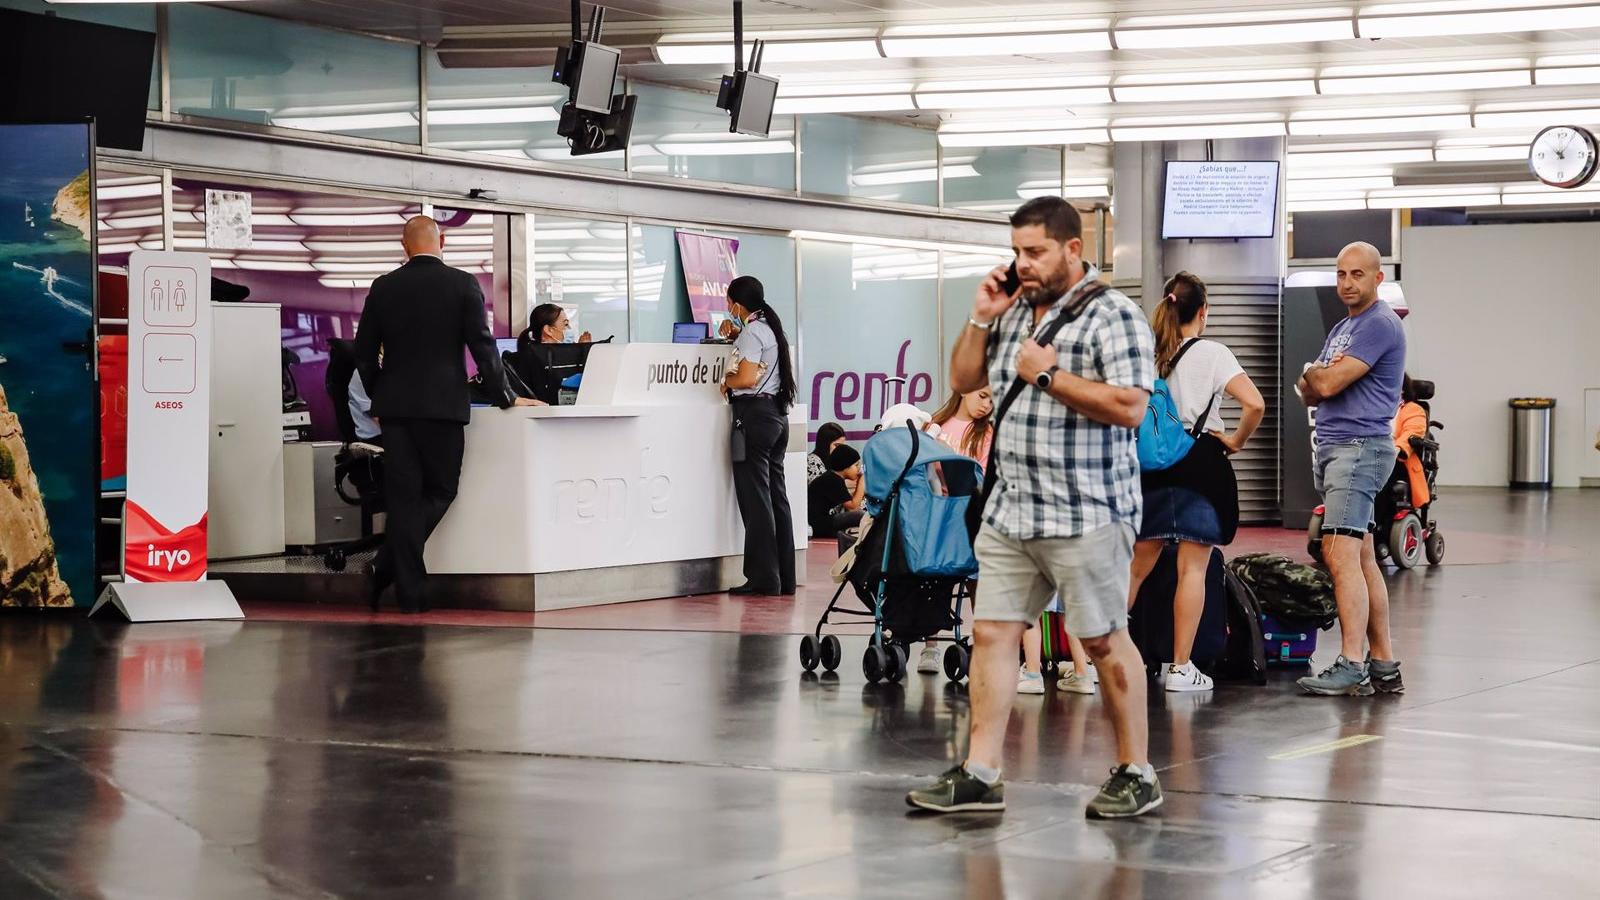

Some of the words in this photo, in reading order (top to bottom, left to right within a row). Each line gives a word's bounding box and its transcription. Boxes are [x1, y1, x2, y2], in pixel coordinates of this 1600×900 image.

[647, 359, 688, 391] punto
[692, 356, 709, 384] de
[810, 339, 933, 421] renfe
[154, 400, 184, 410] ASEOS
[147, 543, 192, 573] iryo
